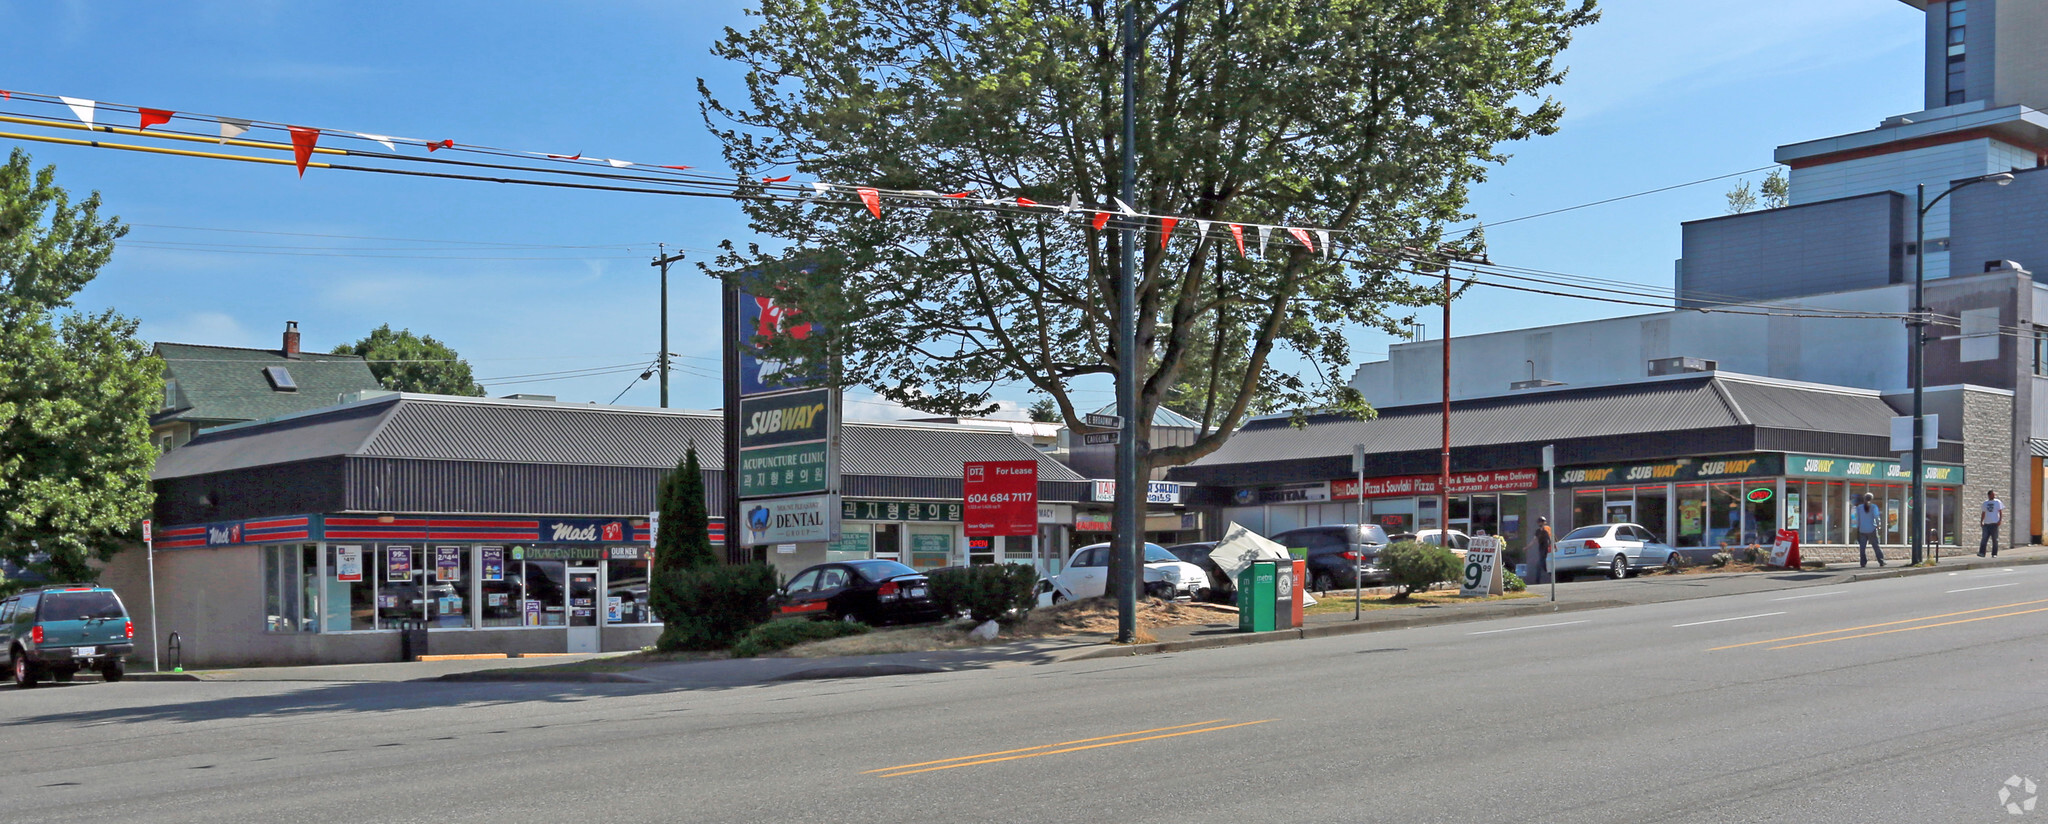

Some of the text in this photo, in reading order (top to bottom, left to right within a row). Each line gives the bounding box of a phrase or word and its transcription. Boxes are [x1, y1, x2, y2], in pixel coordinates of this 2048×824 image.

[745, 402, 825, 437] SUBWAY
[743, 450, 825, 470] ACUPUNCTURE CLINIC
[1697, 458, 1757, 476] SUBWAY
[1804, 458, 1835, 473] SUBWAY
[969, 467, 984, 476] DTZ
[996, 467, 1033, 475] For Lease
[1561, 467, 1614, 483] SUBWAY
[1626, 464, 1683, 480] SUBWAY
[1846, 461, 1876, 476] SUBWAY
[1924, 466, 1951, 480] SUBWAY
[1463, 475, 1476, 484] Take
[1477, 474, 1490, 483] Out
[1494, 473, 1509, 482] Free
[1509, 471, 1537, 480] Delivery
[1364, 481, 1380, 494] Pizza
[1380, 485, 1386, 493] &
[1386, 479, 1412, 493] Souvlaki
[1414, 478, 1435, 492] Pizza
[967, 492, 1033, 503] 604 684 7117
[1750, 490, 1769, 499] OPEN
[776, 511, 824, 529] DENTAL
[552, 523, 598, 541] Mac's
[785, 529, 811, 538] GROUP
[611, 547, 638, 555] OUR NEW
[969, 540, 989, 548] OPEN
[1468, 553, 1493, 564] CUT
[1256, 574, 1273, 582] metro
[1463, 562, 1492, 590] 9 99
